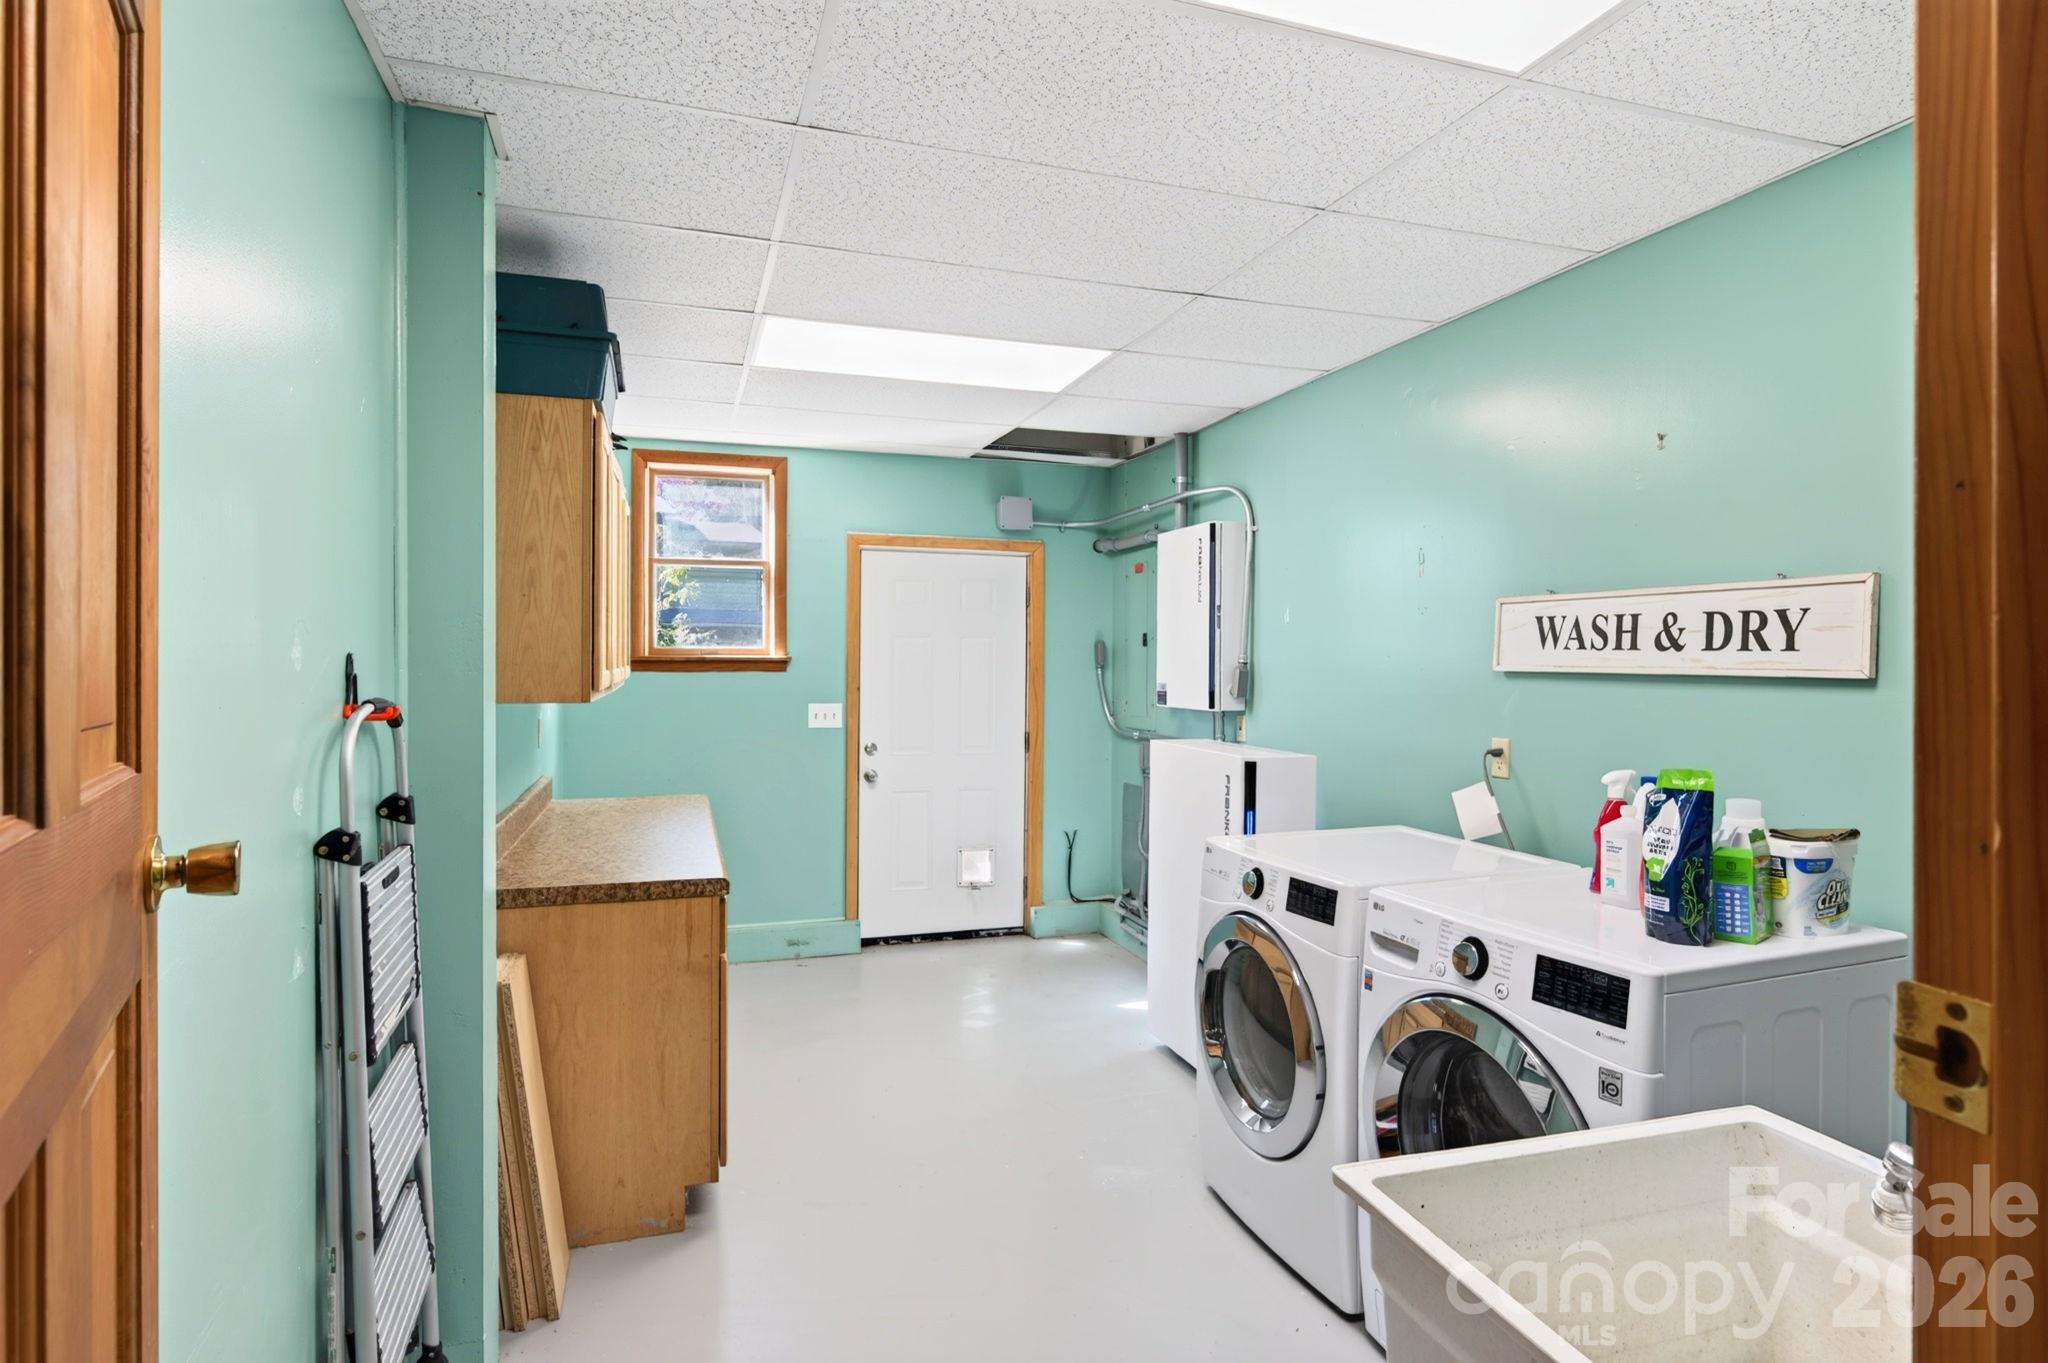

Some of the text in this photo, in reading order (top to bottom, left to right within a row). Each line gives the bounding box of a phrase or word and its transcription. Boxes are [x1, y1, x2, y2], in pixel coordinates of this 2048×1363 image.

[1535, 607, 1811, 653] WASH & DRY
